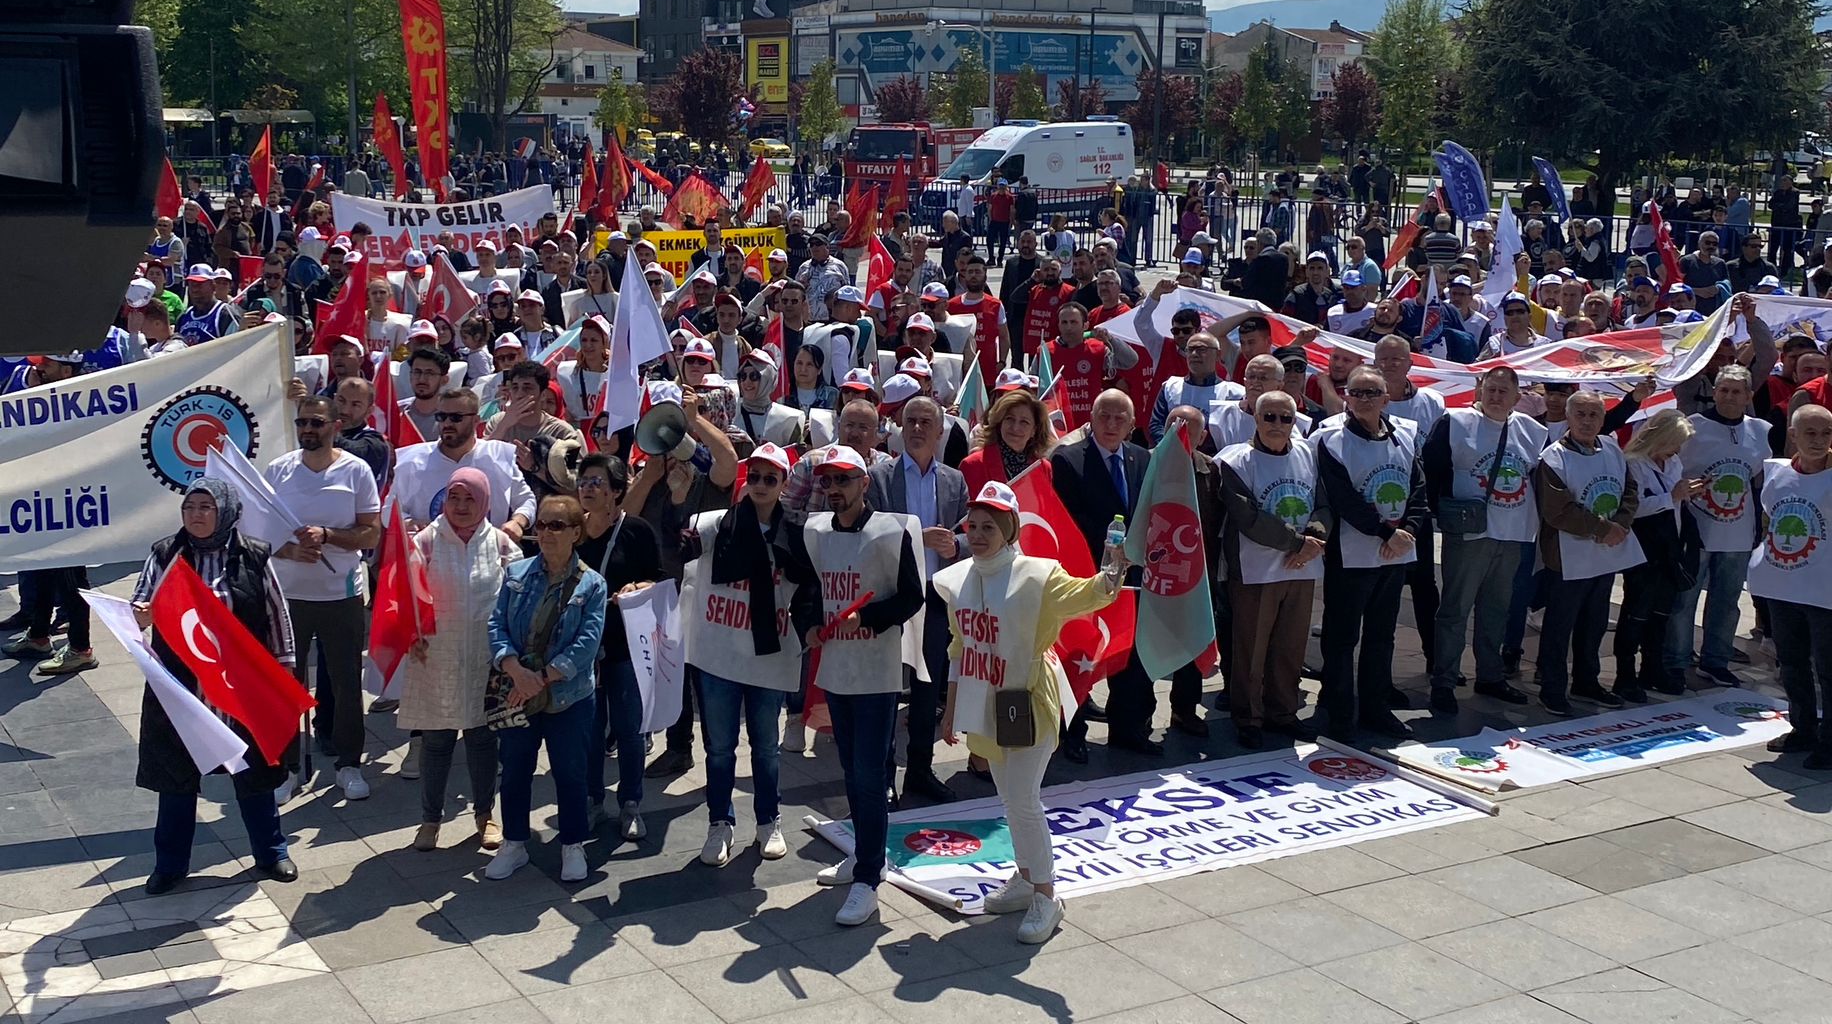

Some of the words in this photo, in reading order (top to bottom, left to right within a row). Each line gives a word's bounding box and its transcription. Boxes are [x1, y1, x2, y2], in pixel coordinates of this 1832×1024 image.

[1092, 162, 1112, 175] 112
[383, 206, 430, 227] TKP
[436, 199, 506, 226] GELİR
[659, 238, 700, 251] EKMEK
[721, 232, 775, 249] ZGÜRLÜK
[366, 336, 392, 352] EKSİF
[0, 382, 139, 428] NDİKASI
[161, 398, 204, 428] TÜRK
[0, 485, 110, 535] CİLİĞİ
[706, 593, 789, 637] SENDSI
[639, 634, 653, 677] CHP
[1045, 770, 1298, 836] EKSİF
[958, 838, 1117, 874] TETİL
[1115, 816, 1233, 845] ÖRME
[1229, 807, 1287, 824] VE
[1117, 829, 1280, 869] İŞÇİLERİ
[1278, 798, 1459, 841] SENDİKAS
